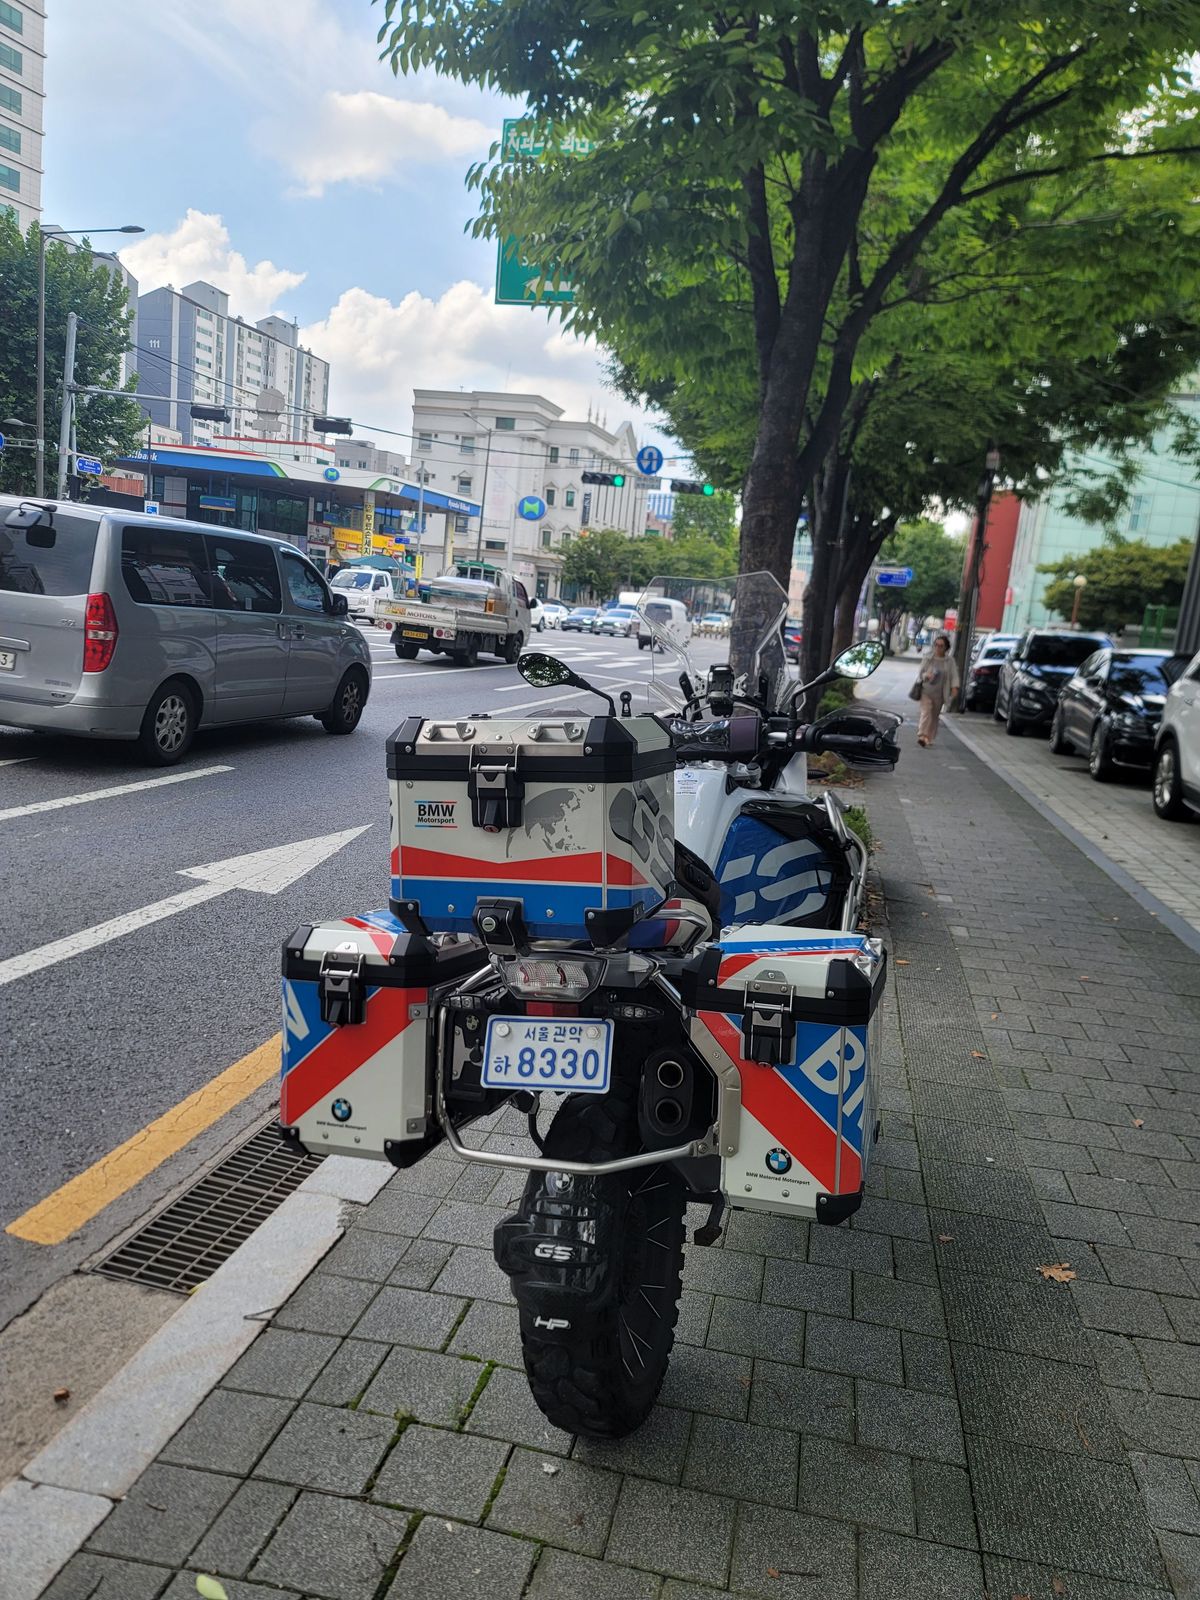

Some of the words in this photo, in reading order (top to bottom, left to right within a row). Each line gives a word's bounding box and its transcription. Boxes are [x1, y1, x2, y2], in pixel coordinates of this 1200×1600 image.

[149, 339, 160, 349] 111
[418, 804, 455, 817] BMW
[417, 817, 455, 825] Motorsport
[493, 1055, 512, 1076] 하
[517, 1047, 600, 1081] 8330
[782, 1177, 810, 1186] Motorsport
[534, 1244, 574, 1261] GS
[534, 1315, 571, 1330] HP
